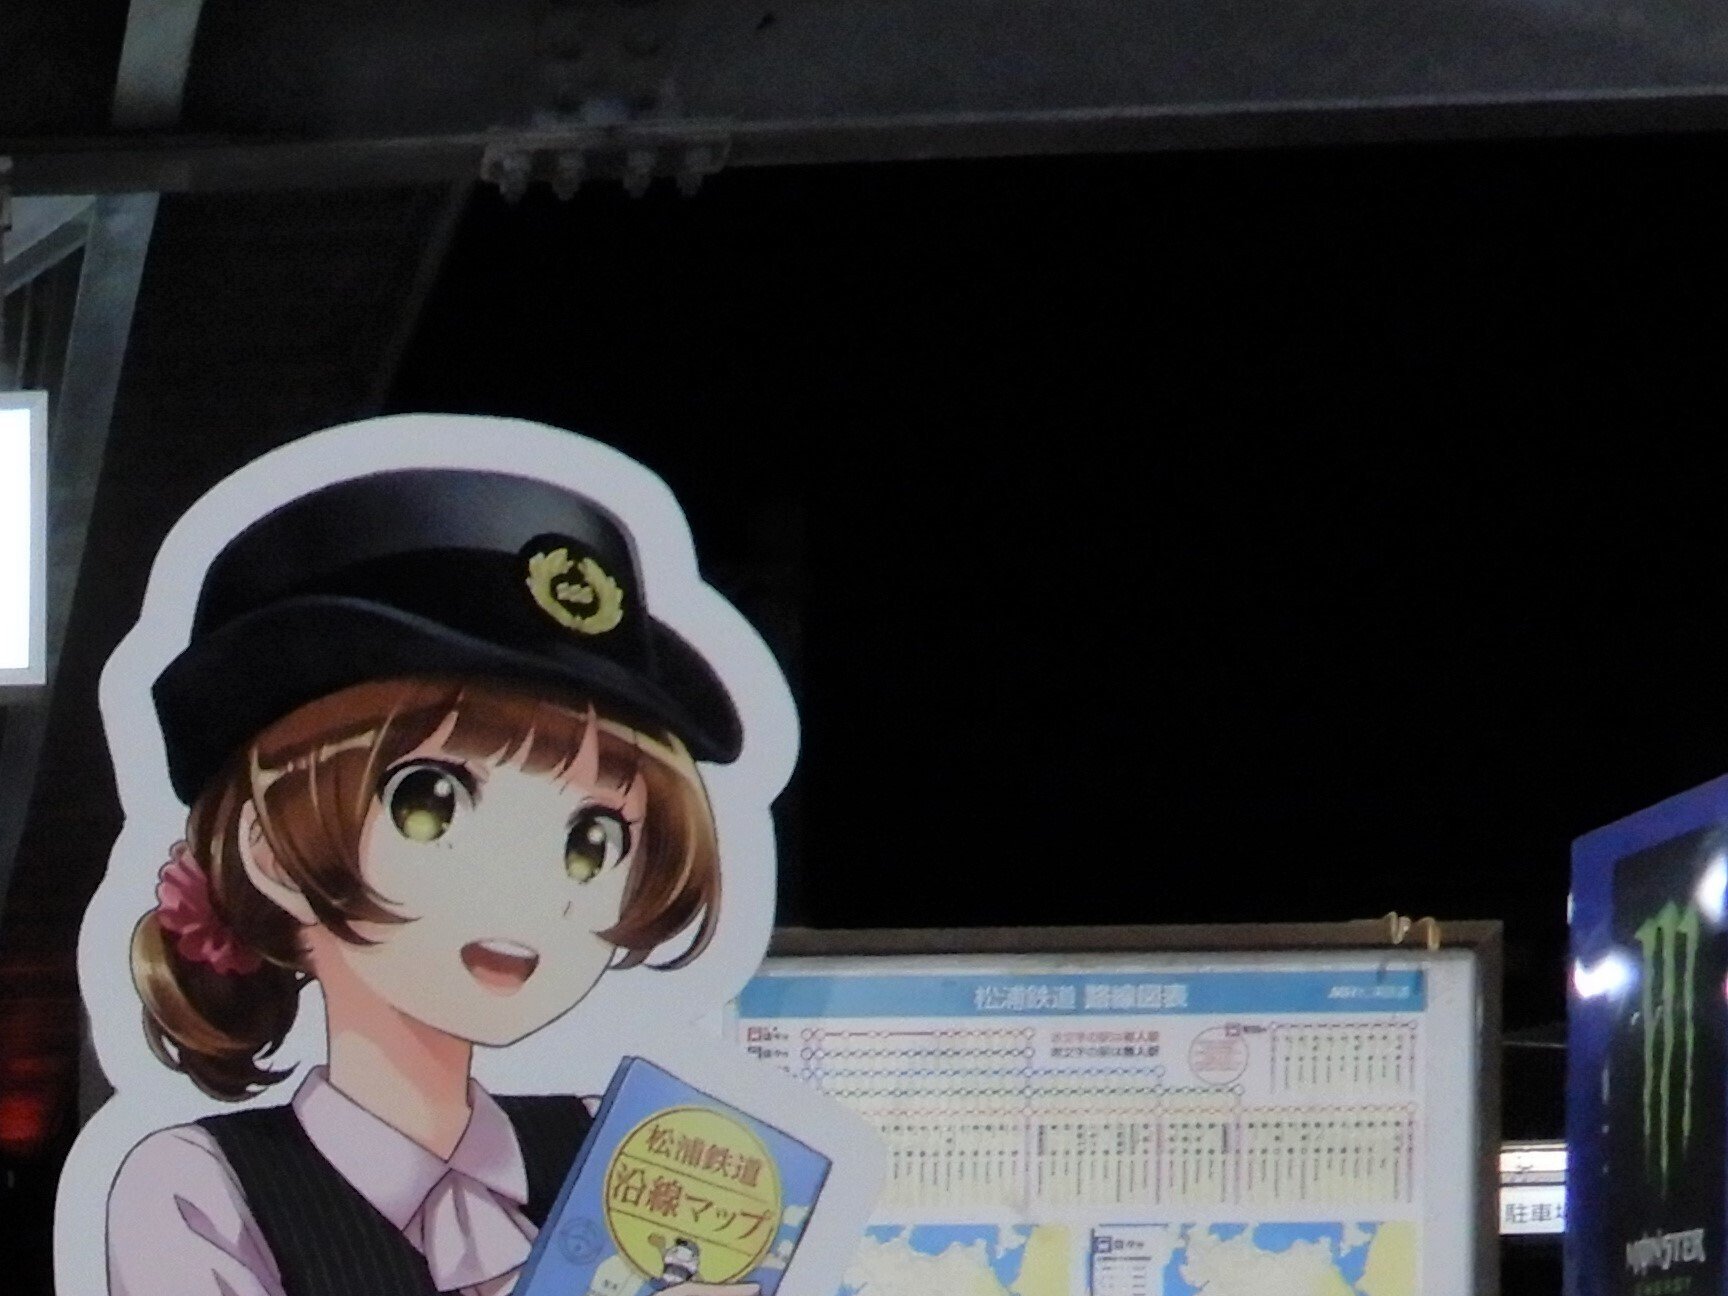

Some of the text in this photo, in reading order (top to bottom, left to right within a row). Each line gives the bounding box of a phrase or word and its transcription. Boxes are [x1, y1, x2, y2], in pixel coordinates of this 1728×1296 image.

[645, 1124, 763, 1188] 松浦鉄道
[613, 1162, 772, 1241] 沿線マップ
